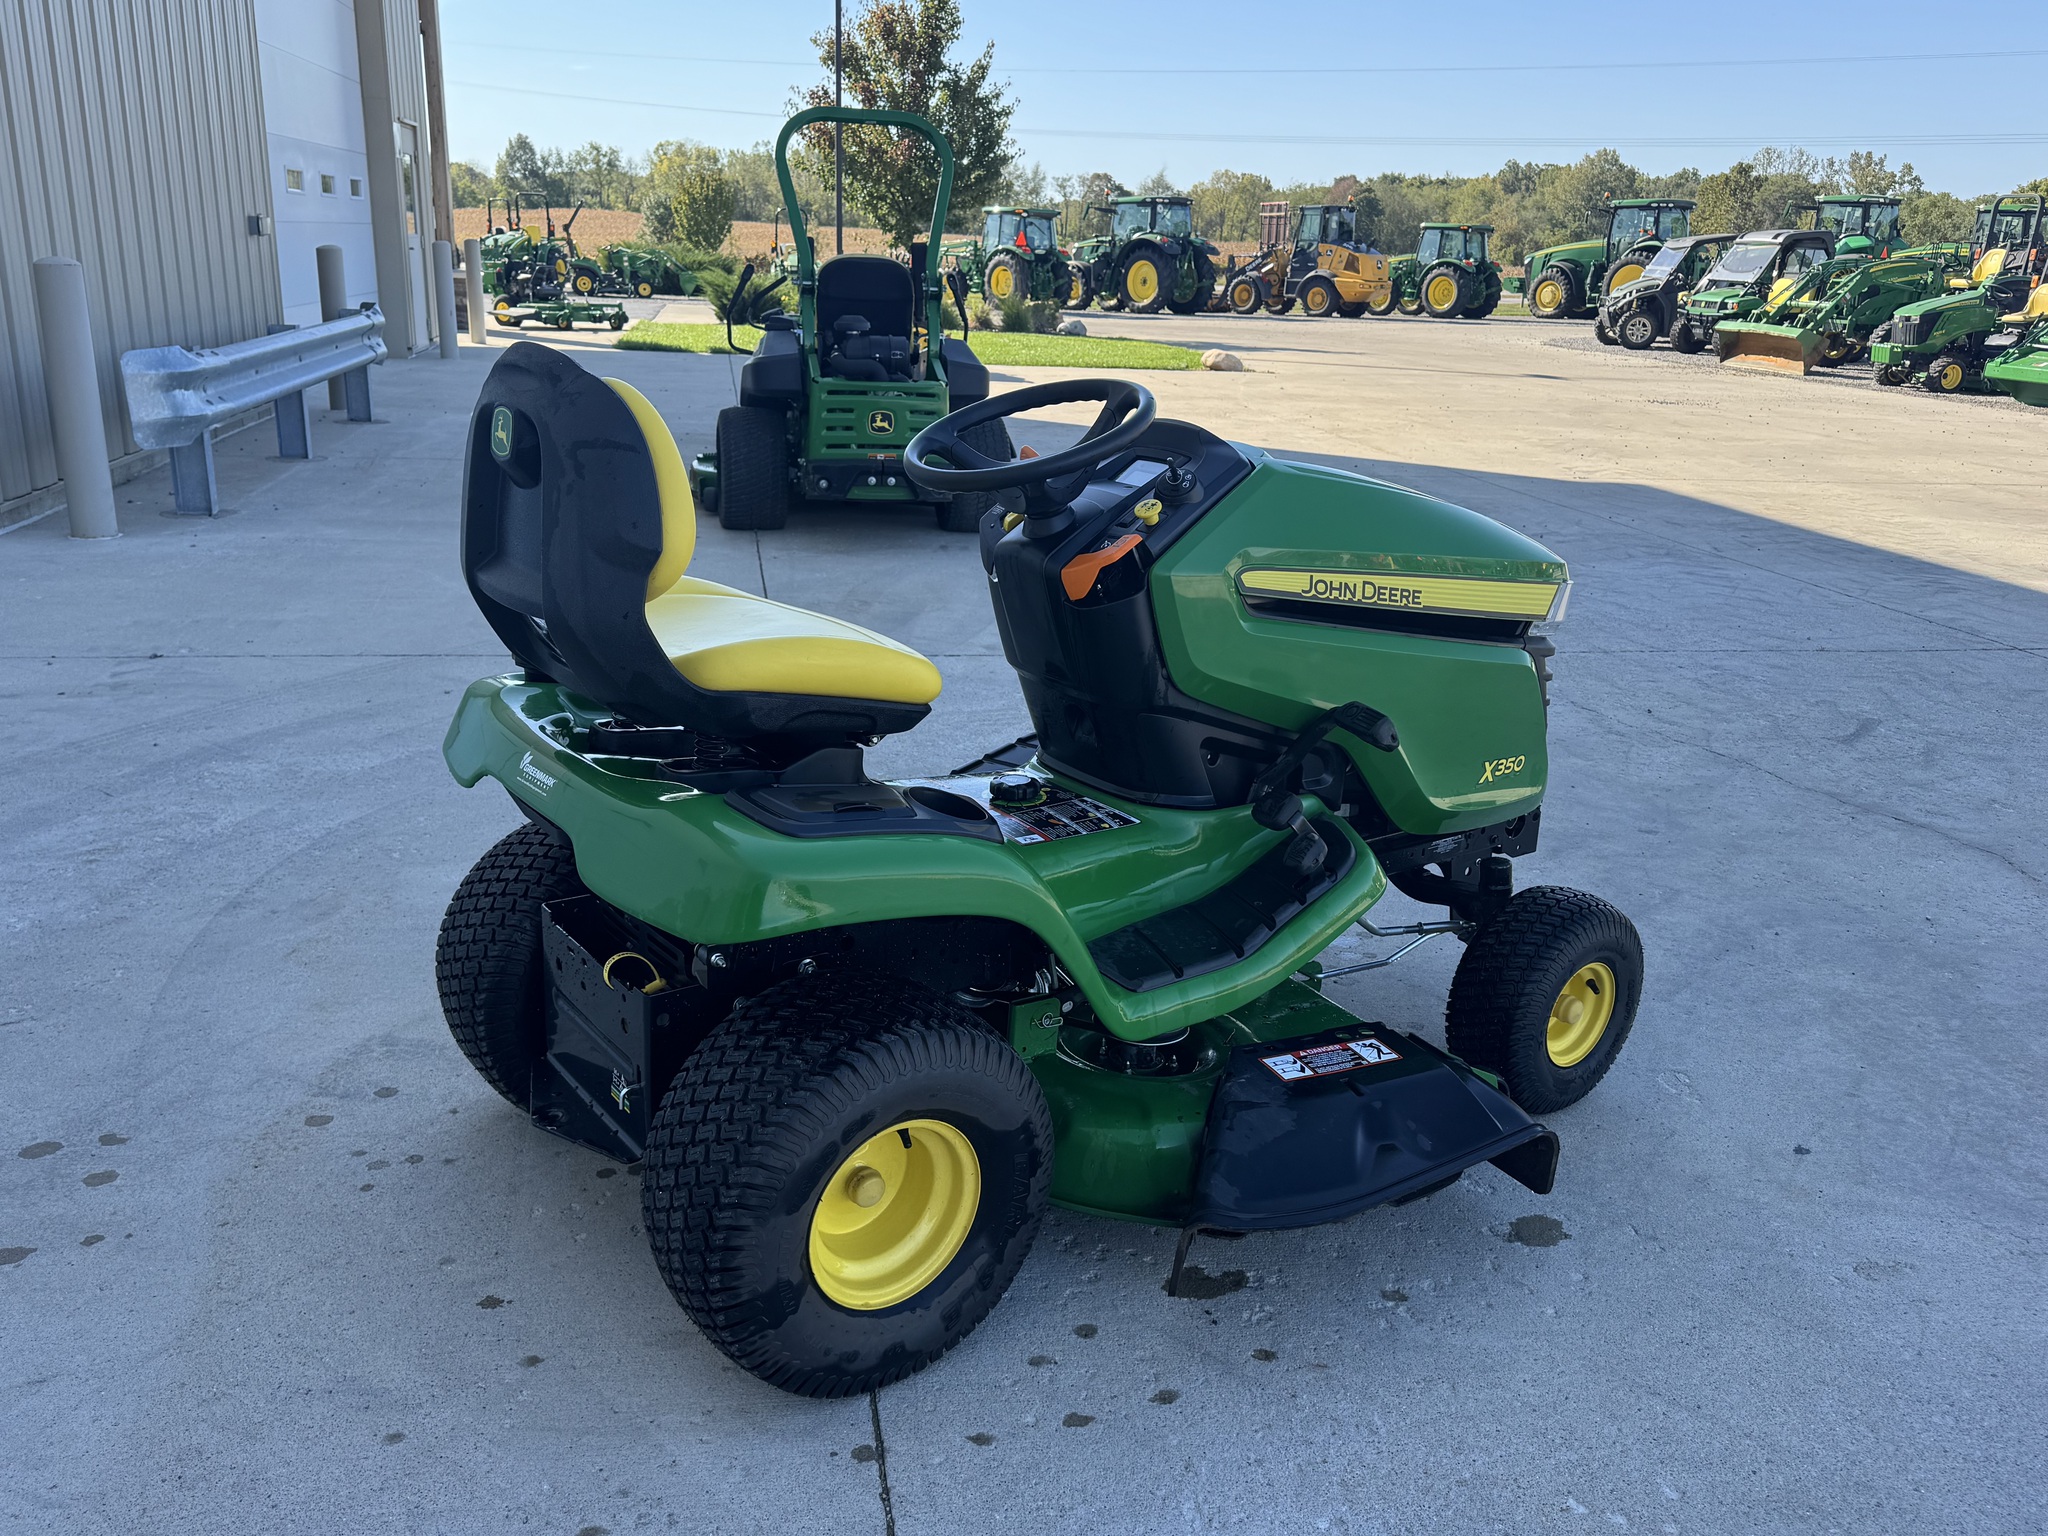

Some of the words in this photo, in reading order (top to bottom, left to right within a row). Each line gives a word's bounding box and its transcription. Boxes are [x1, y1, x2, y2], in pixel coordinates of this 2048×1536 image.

[1301, 574, 1357, 600] JOHN
[1361, 580, 1423, 607] DEERE
[523, 763, 557, 788] GREENMARK
[1478, 754, 1526, 785] X350
[1307, 1044, 1342, 1054] DANGER
